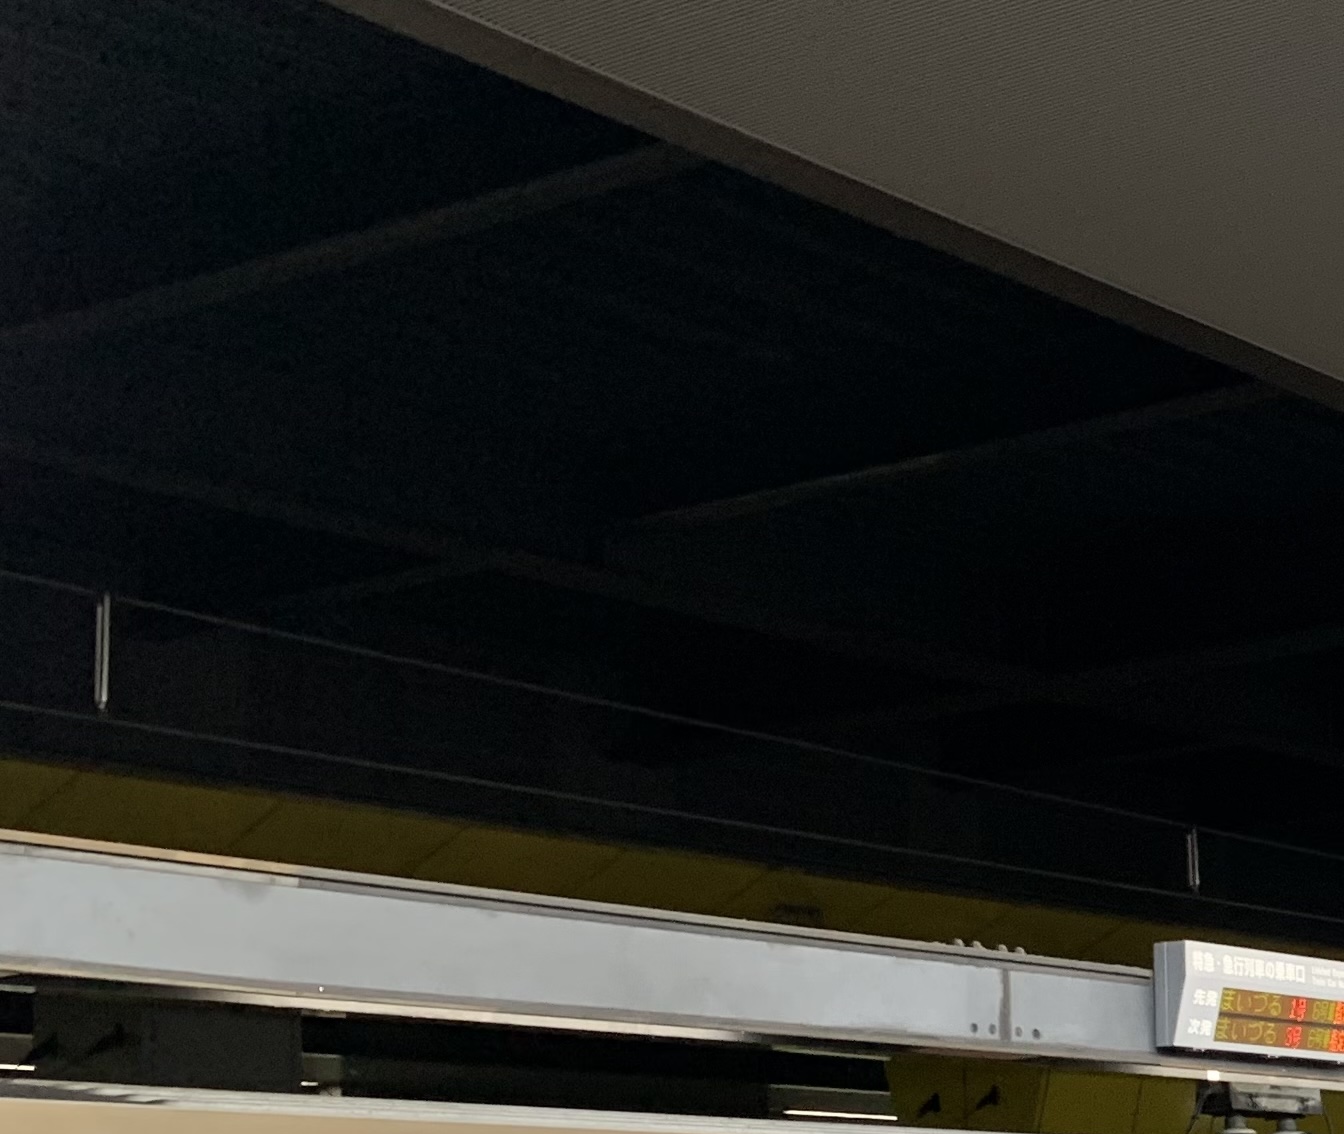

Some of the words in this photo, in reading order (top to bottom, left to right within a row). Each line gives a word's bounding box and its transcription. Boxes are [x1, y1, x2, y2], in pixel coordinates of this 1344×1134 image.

[1221, 989, 1282, 1017] まいづる
[1214, 1017, 1277, 1044] まいづる
